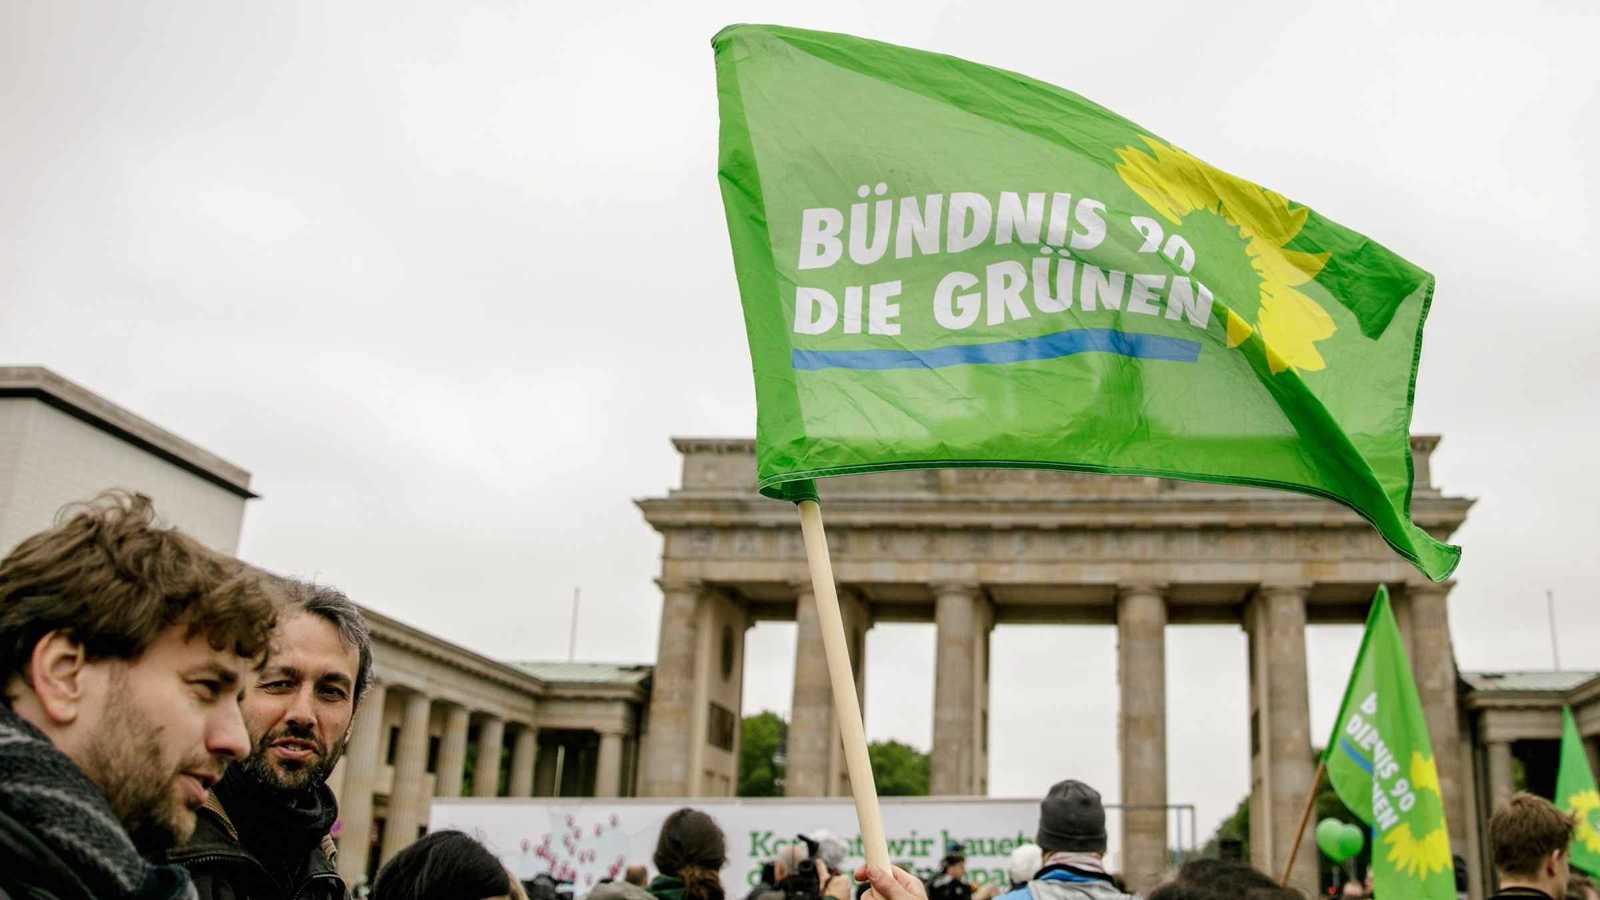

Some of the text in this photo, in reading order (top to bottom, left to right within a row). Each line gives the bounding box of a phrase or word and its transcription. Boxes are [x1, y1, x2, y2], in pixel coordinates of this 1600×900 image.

[798, 182, 1195, 273] BÜNDNIS 90
[793, 246, 1214, 336] DIE GRÜNEN
[1391, 778, 1416, 813] 90
[887, 831, 934, 857] wir
